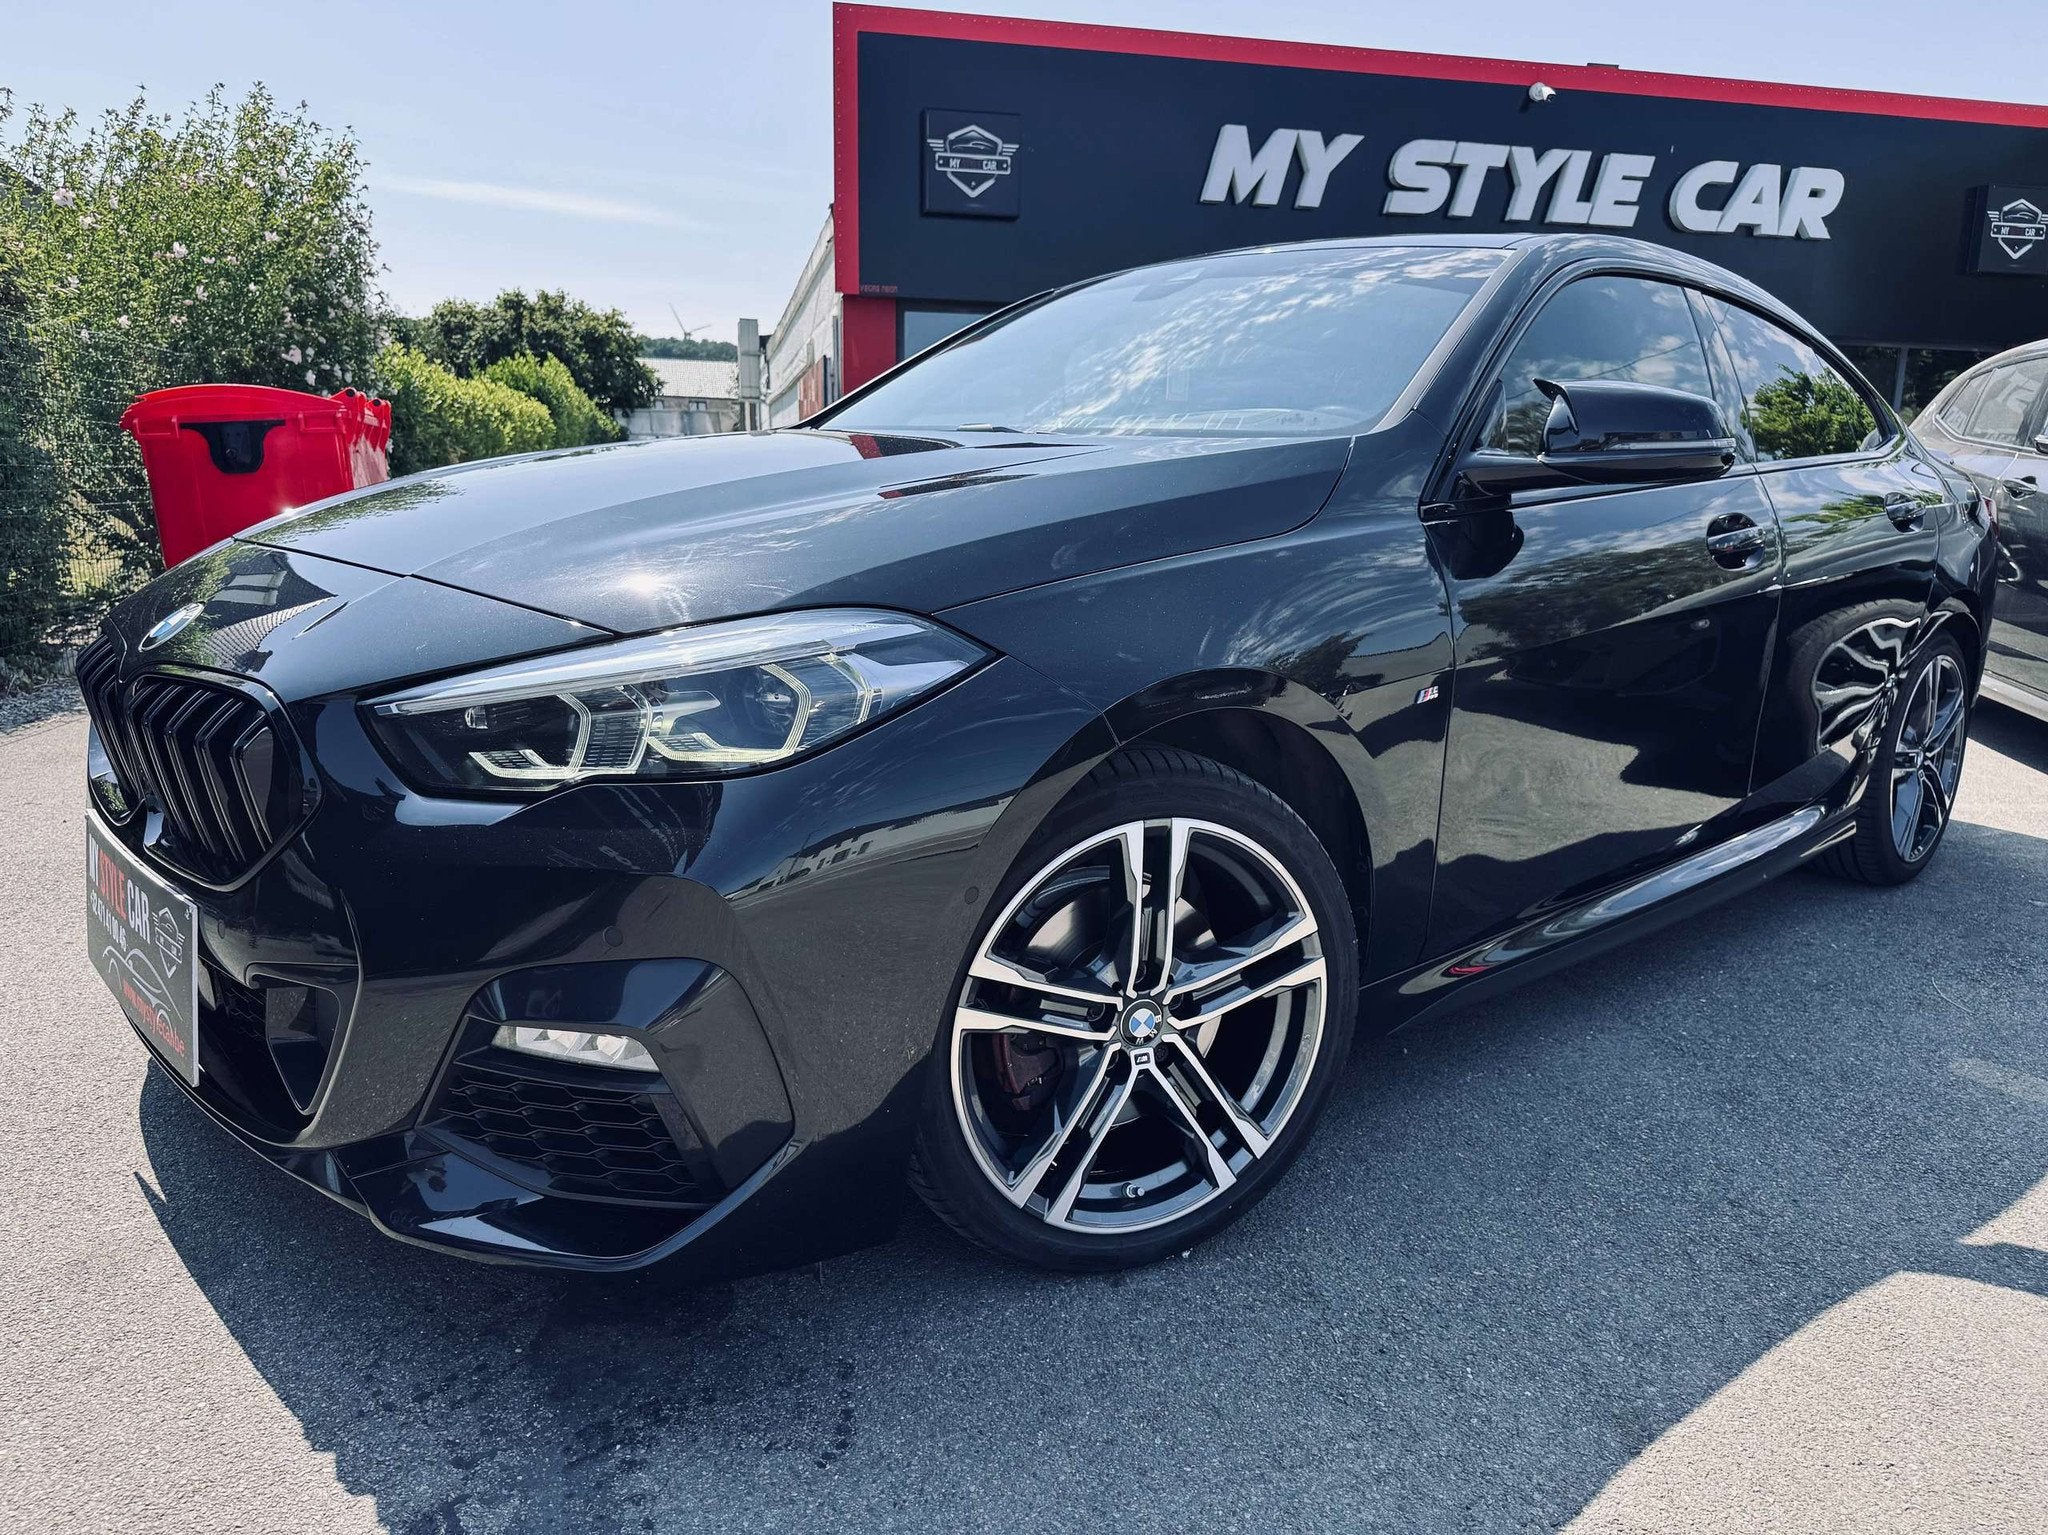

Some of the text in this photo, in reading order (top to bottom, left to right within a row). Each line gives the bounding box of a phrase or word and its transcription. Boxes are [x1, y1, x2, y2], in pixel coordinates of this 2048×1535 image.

[949, 158, 961, 170] MY
[982, 160, 997, 171] CAR
[1200, 123, 1845, 240] MY STYLE CAR
[2000, 226, 2010, 236] MY
[2024, 228, 2036, 237] CAR
[89, 833, 150, 945] MY STYLE CAR
